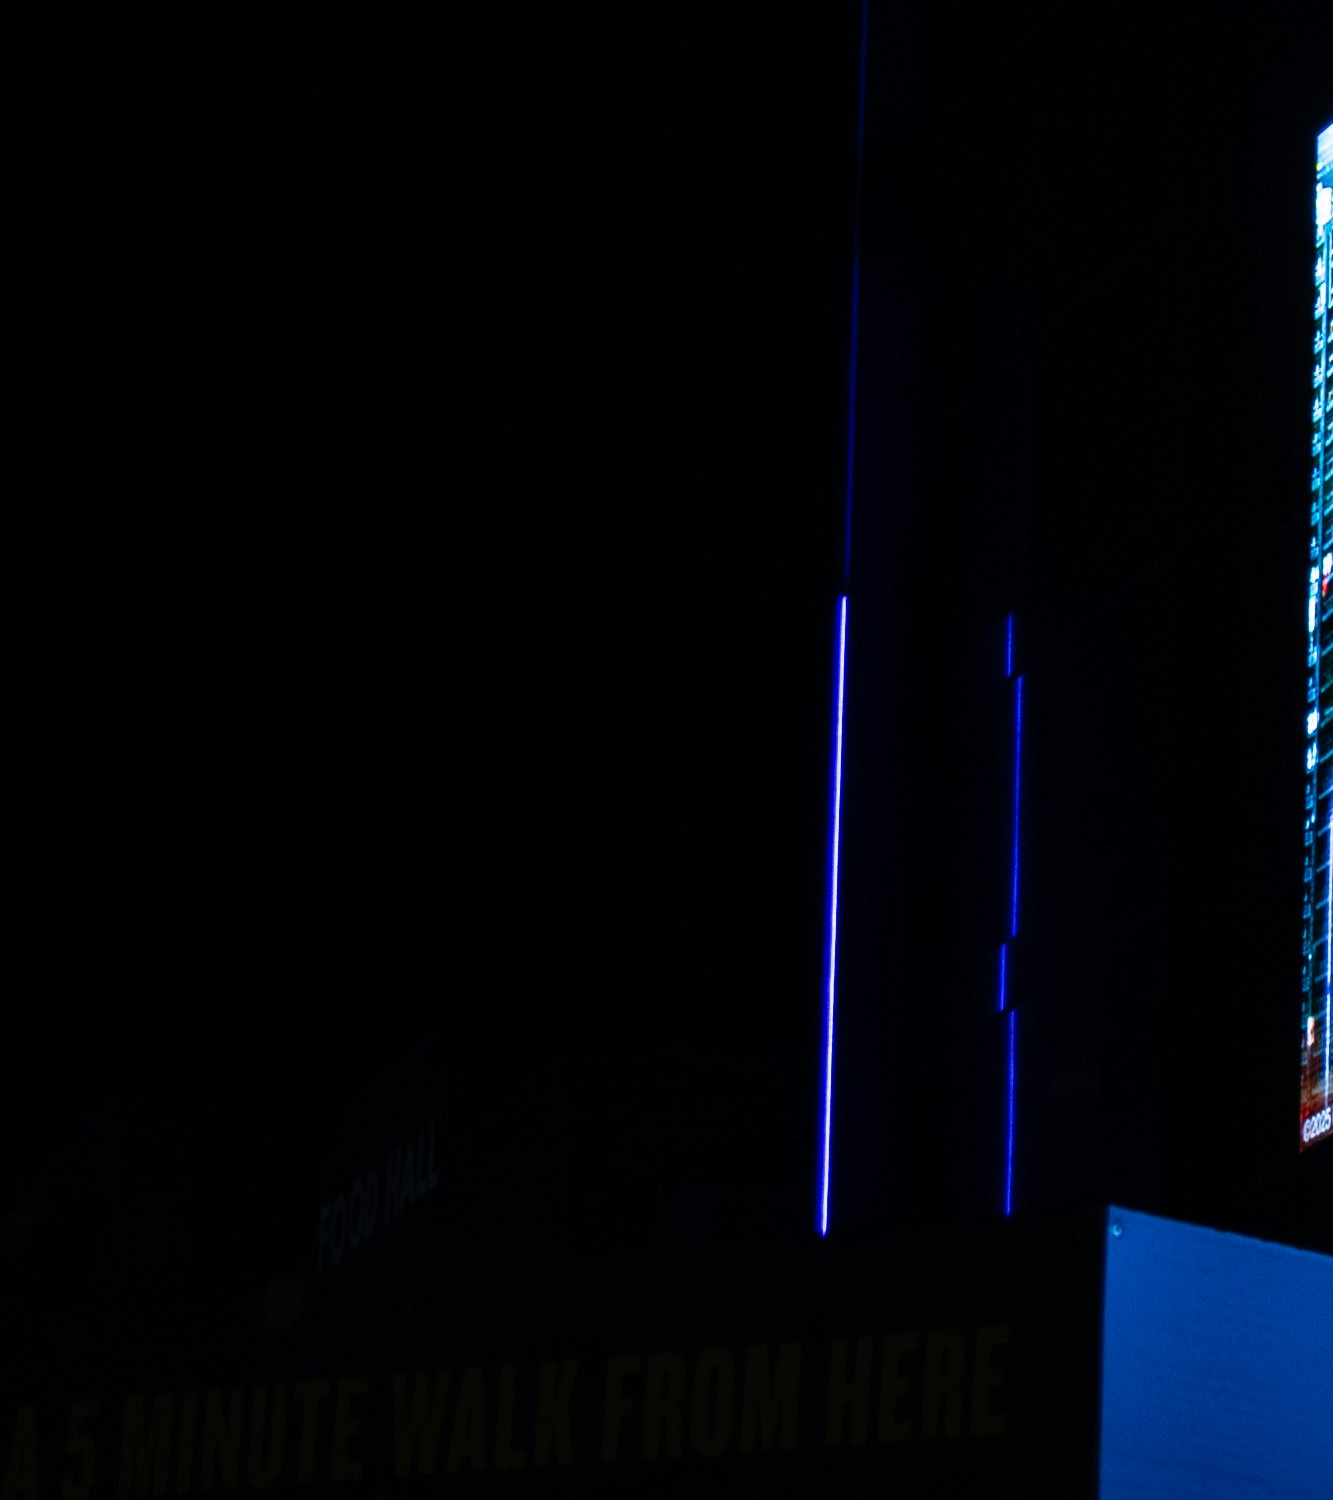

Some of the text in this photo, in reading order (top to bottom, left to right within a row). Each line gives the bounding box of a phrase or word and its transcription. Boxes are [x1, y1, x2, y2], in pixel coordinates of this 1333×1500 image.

[117, 1374, 371, 1500] MINUTE
[390, 1357, 580, 1478] WALK
[599, 1339, 800, 1464] FROM
[824, 1323, 1015, 1448] HERE
